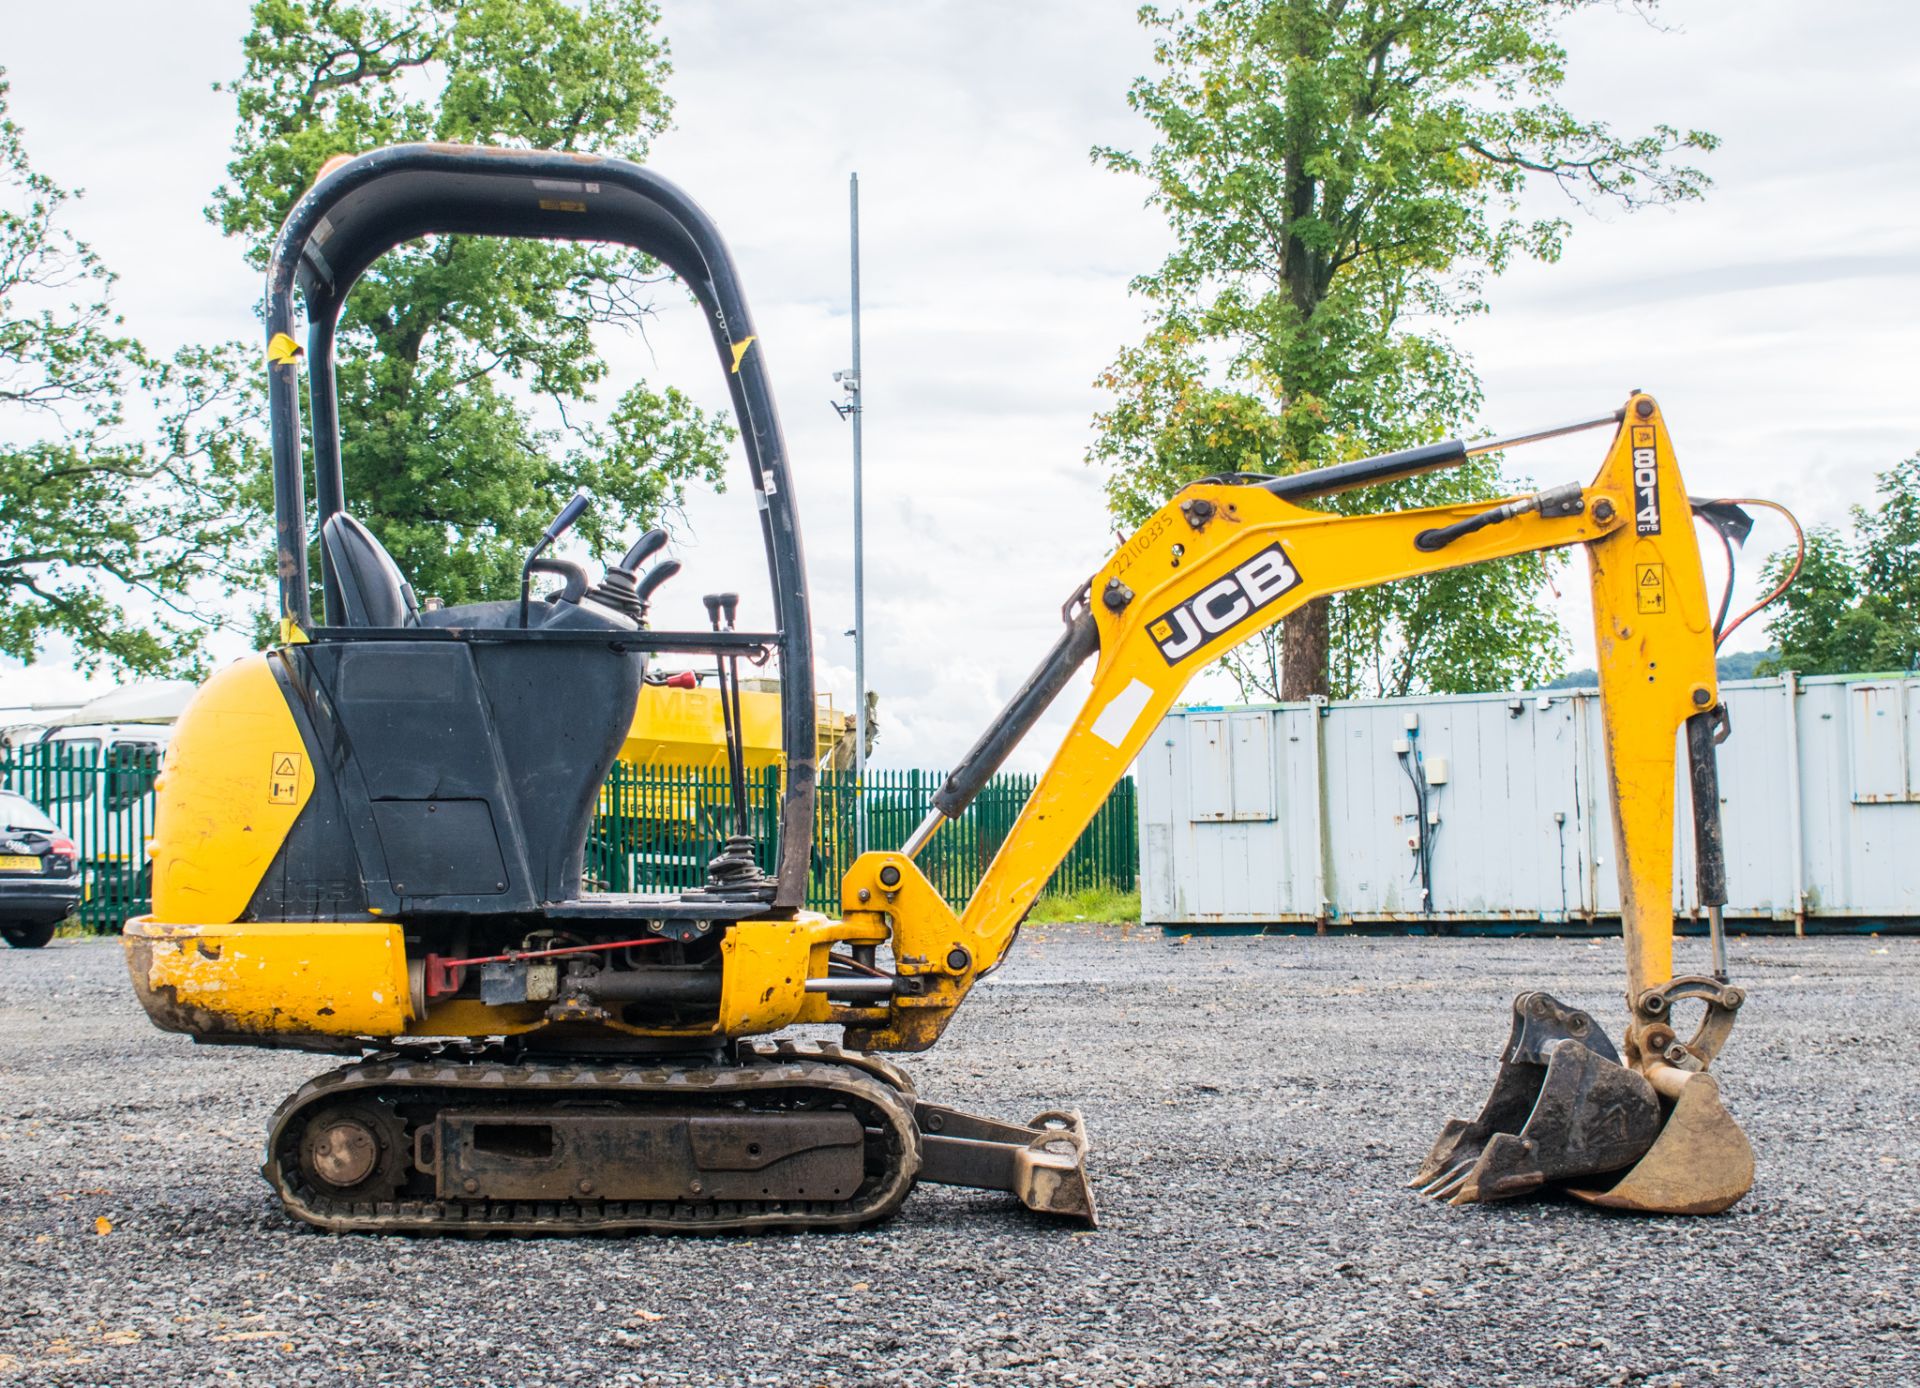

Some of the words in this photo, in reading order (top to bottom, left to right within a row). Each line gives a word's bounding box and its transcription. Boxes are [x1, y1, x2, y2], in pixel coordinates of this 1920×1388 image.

[1633, 448, 1659, 525] 8014
[1112, 513, 1174, 575] 22110335
[1637, 524, 1659, 532] CTS
[1161, 550, 1296, 659] JCB
[621, 803, 671, 815] SERVCE
